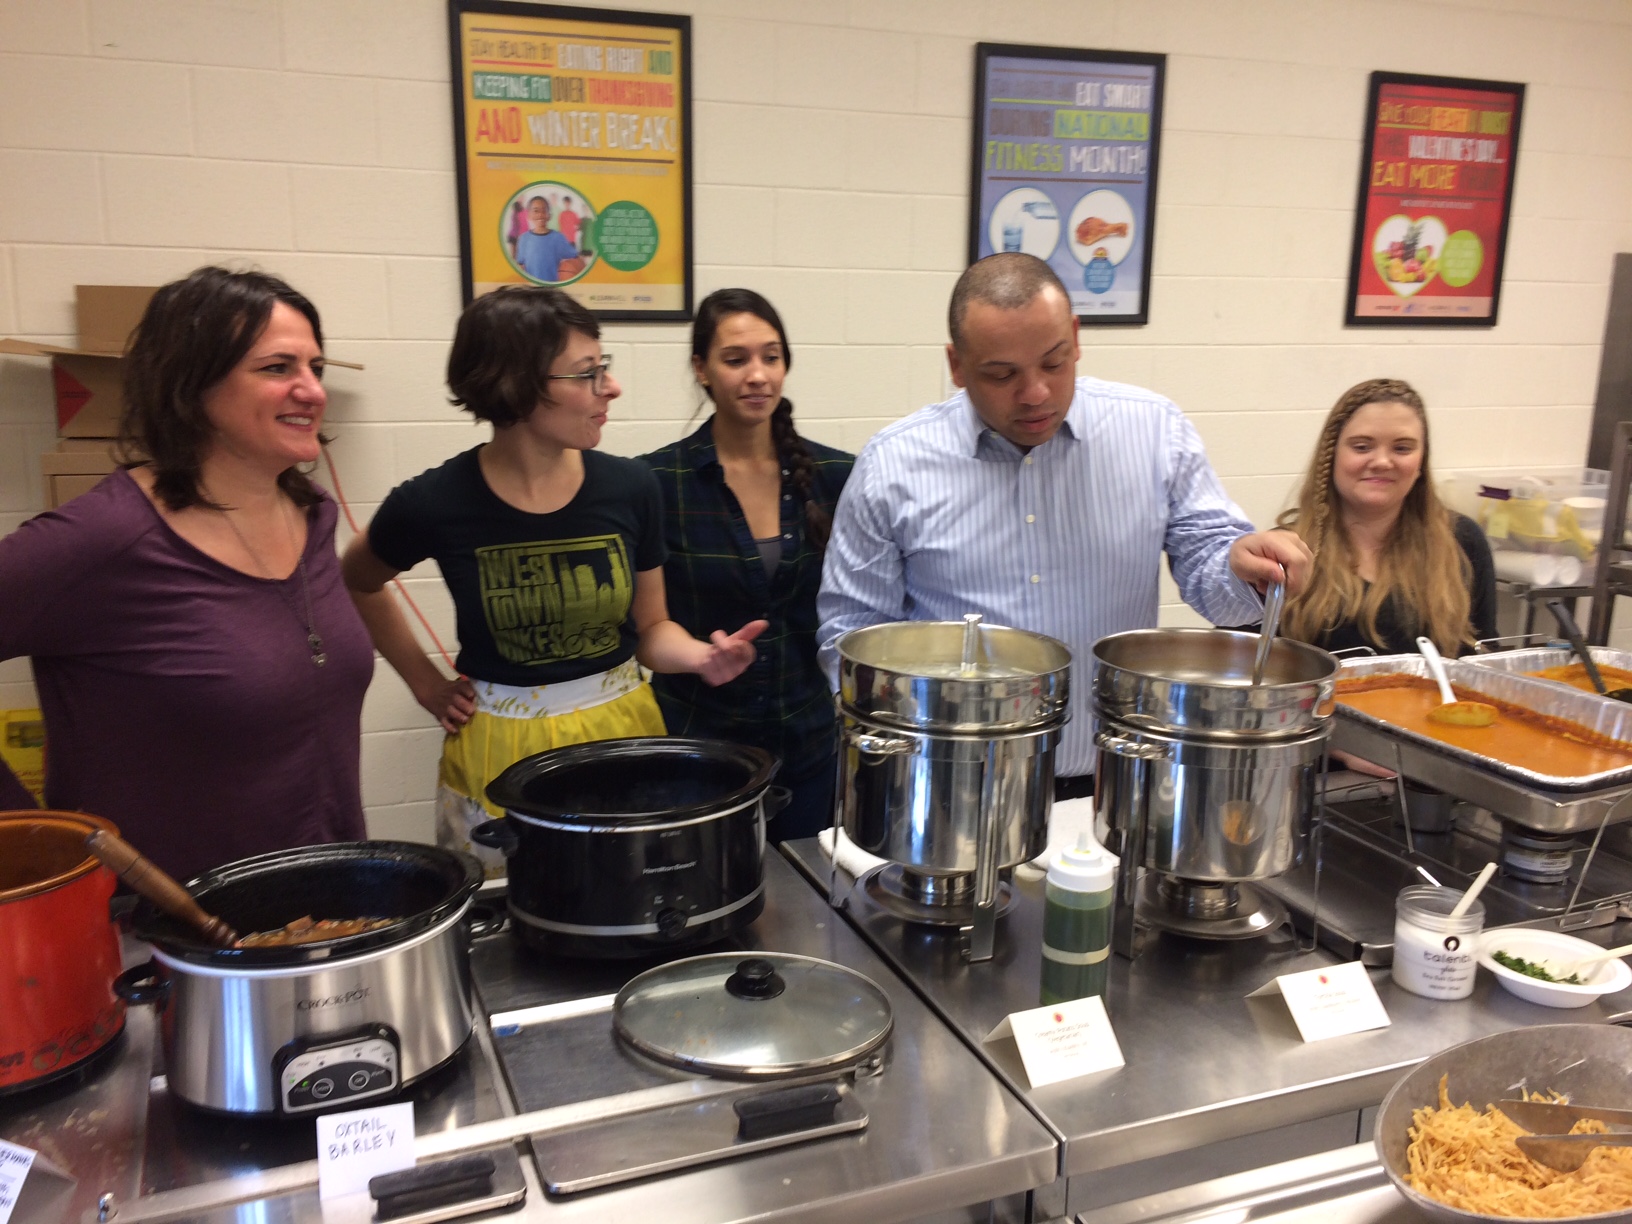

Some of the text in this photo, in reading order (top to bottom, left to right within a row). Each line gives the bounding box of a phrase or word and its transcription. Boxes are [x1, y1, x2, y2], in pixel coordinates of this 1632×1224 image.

[557, 43, 602, 72] EATING
[605, 46, 644, 74] RIGHT
[474, 75, 529, 98] KEEPING
[531, 77, 551, 100] FIT
[1076, 81, 1101, 107] EAT
[1104, 83, 1151, 109] SMART
[474, 106, 678, 153] AND WINTER BREAK!
[1057, 112, 1145, 139] NATIONAL
[985, 140, 1064, 172] FITNESS
[1371, 160, 1407, 187] EAT
[1408, 163, 1458, 190] MORE
[485, 585, 563, 631] TOWN
[335, 1117, 388, 1140] OXTAIL
[328, 1129, 396, 1161] BARLEY
